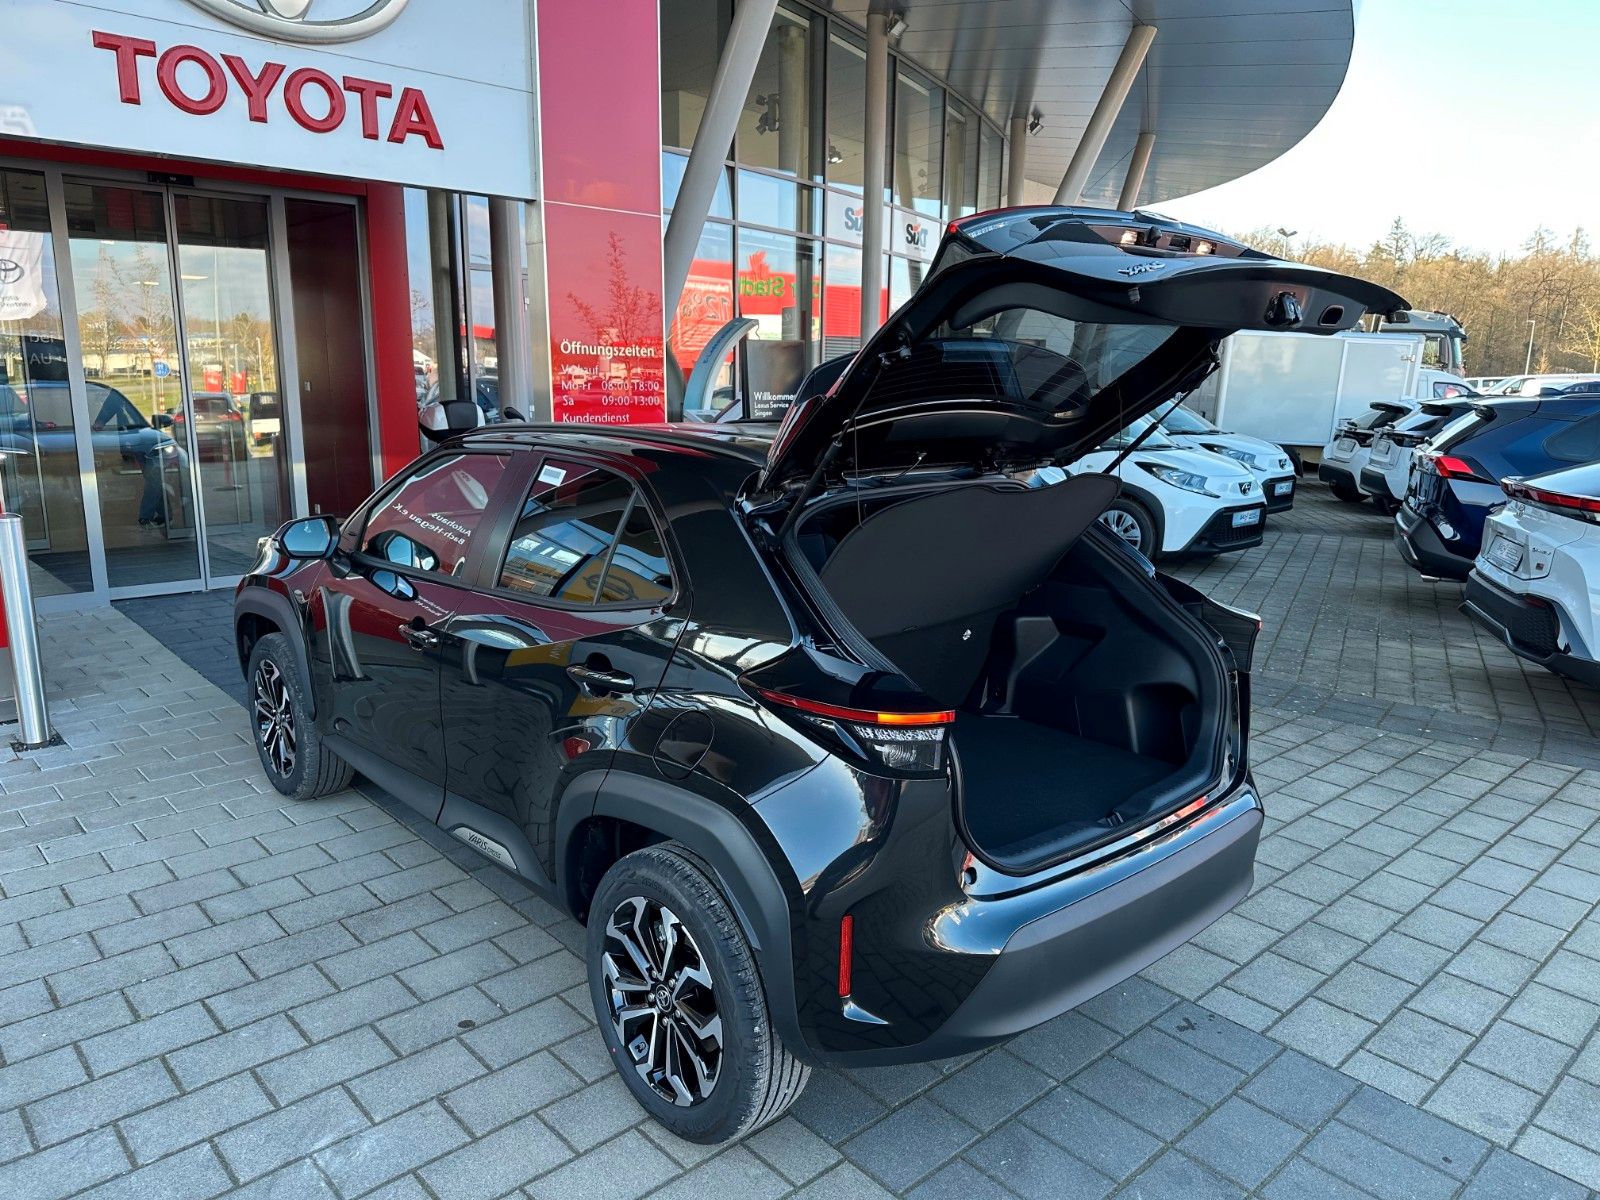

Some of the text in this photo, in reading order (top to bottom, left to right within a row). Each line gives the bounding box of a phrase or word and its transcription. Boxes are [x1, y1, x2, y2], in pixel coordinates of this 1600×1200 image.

[92, 30, 444, 150] TOYOTA
[560, 338, 655, 359] Öffnungszeiten
[561, 364, 599, 376] Vauf
[561, 380, 660, 391] Mo-Fr 08:00-18:00
[562, 395, 660, 406] Sa 09:00-13:00
[770, 401, 789, 409] Service
[562, 412, 630, 423] Kundendienst
[754, 409, 773, 417] Singen
